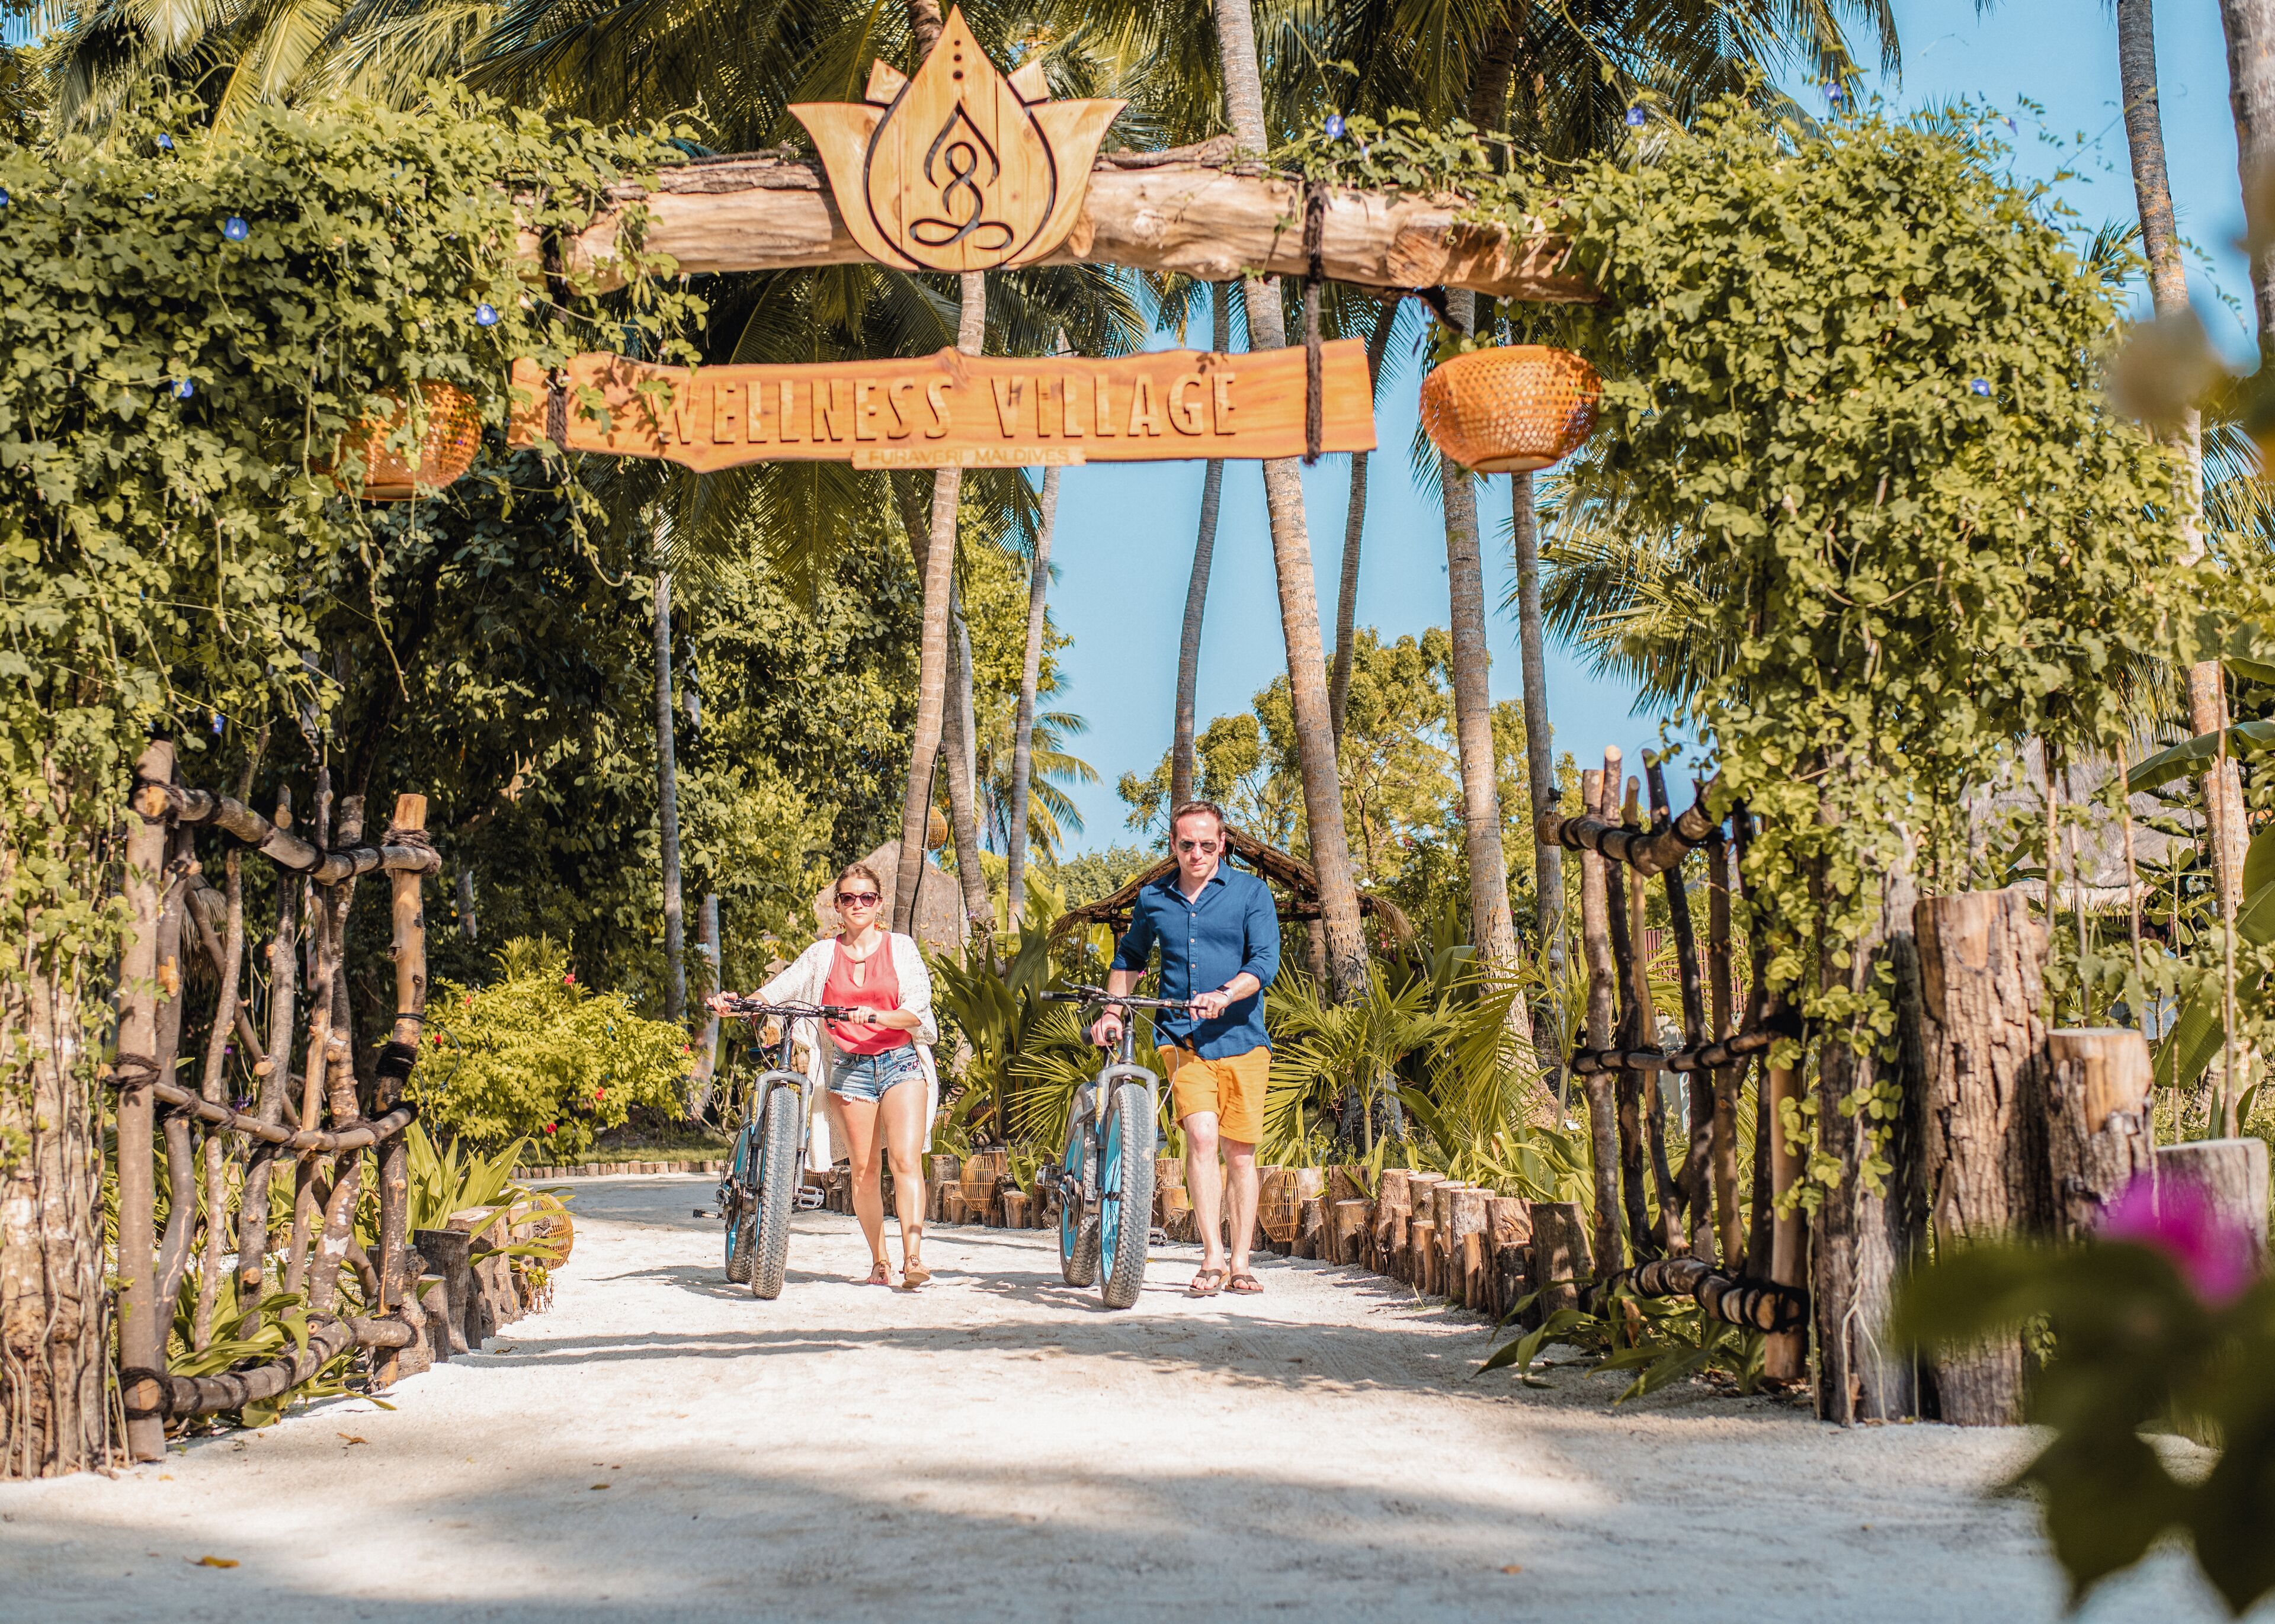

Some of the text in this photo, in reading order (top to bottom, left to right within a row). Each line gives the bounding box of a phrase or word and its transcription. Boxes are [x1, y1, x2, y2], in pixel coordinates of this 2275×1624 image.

[649, 372, 1236, 445] WELLNESS VILLAGE
[869, 448, 1069, 465] FURAVERI MALDIVES
